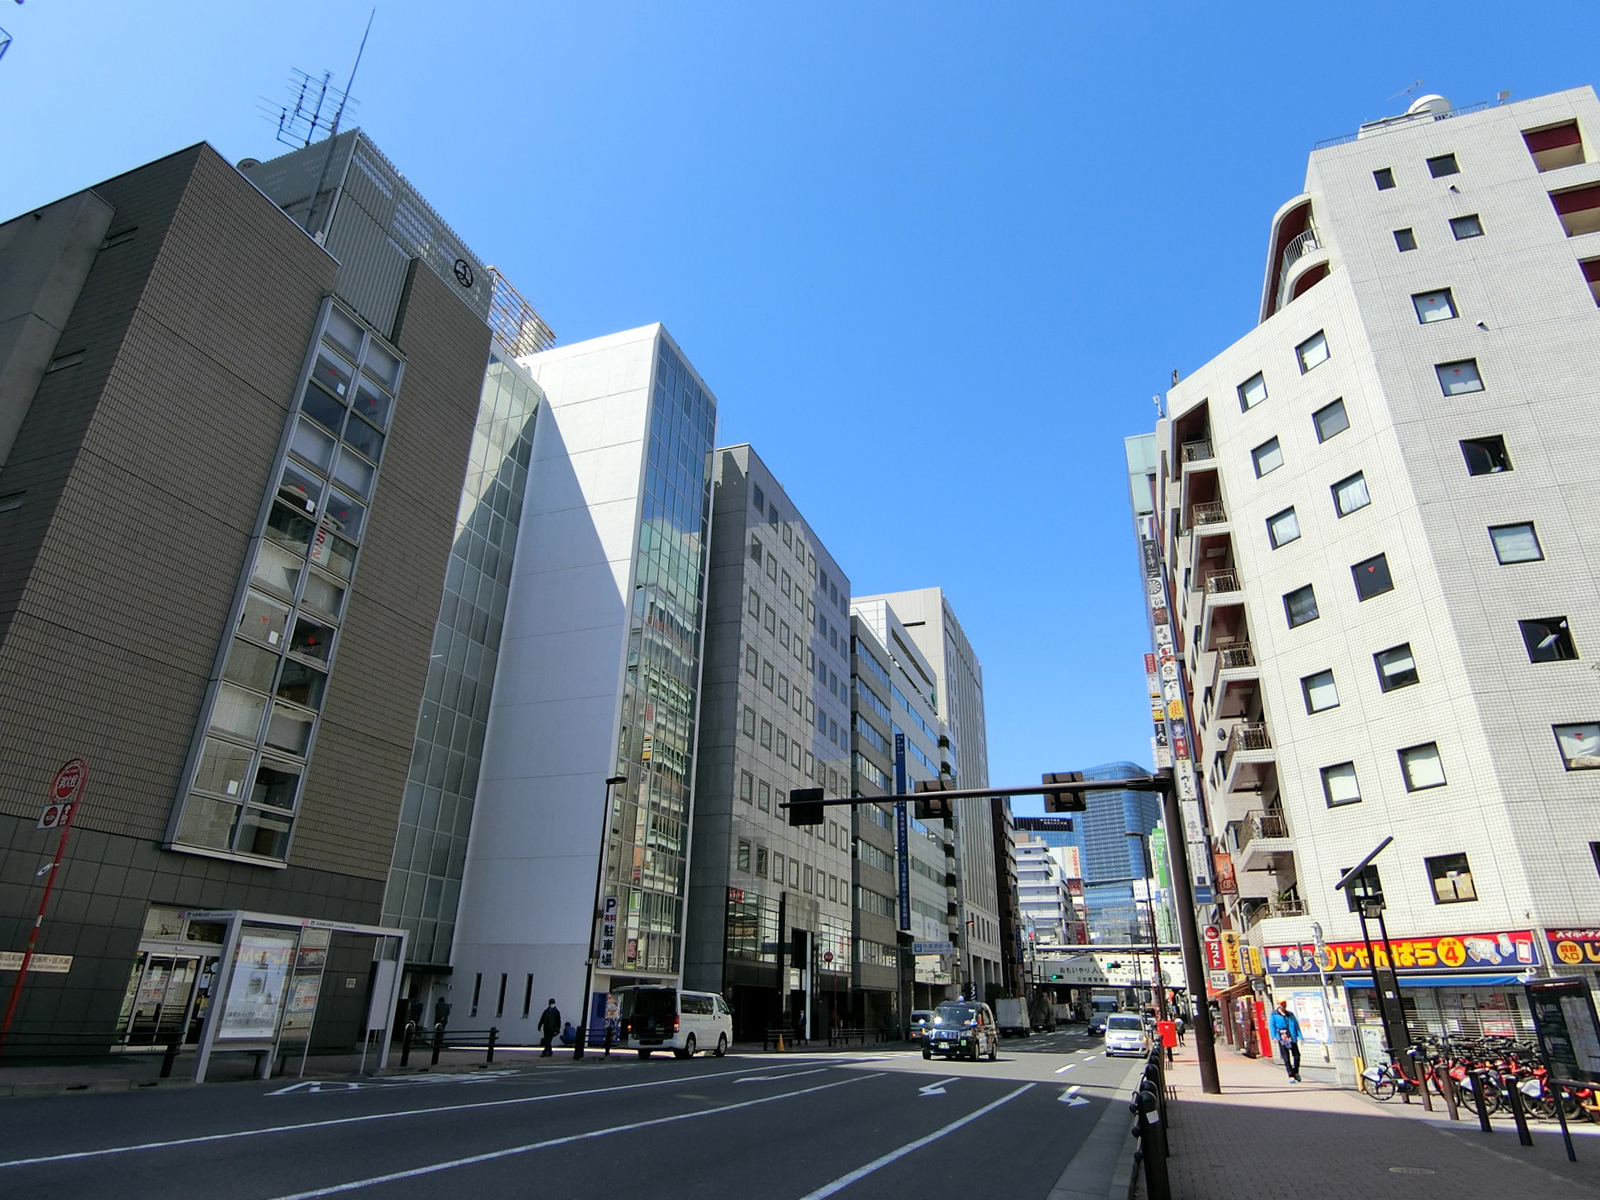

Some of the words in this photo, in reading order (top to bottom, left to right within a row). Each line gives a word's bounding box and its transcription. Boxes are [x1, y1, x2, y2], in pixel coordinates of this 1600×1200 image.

[606, 898, 616, 912] P
[601, 925, 614, 967] 駐車場
[1210, 942, 1221, 967] ガスト
[1336, 942, 1438, 969] じゃんぱら
[1445, 946, 1459, 963] 4
